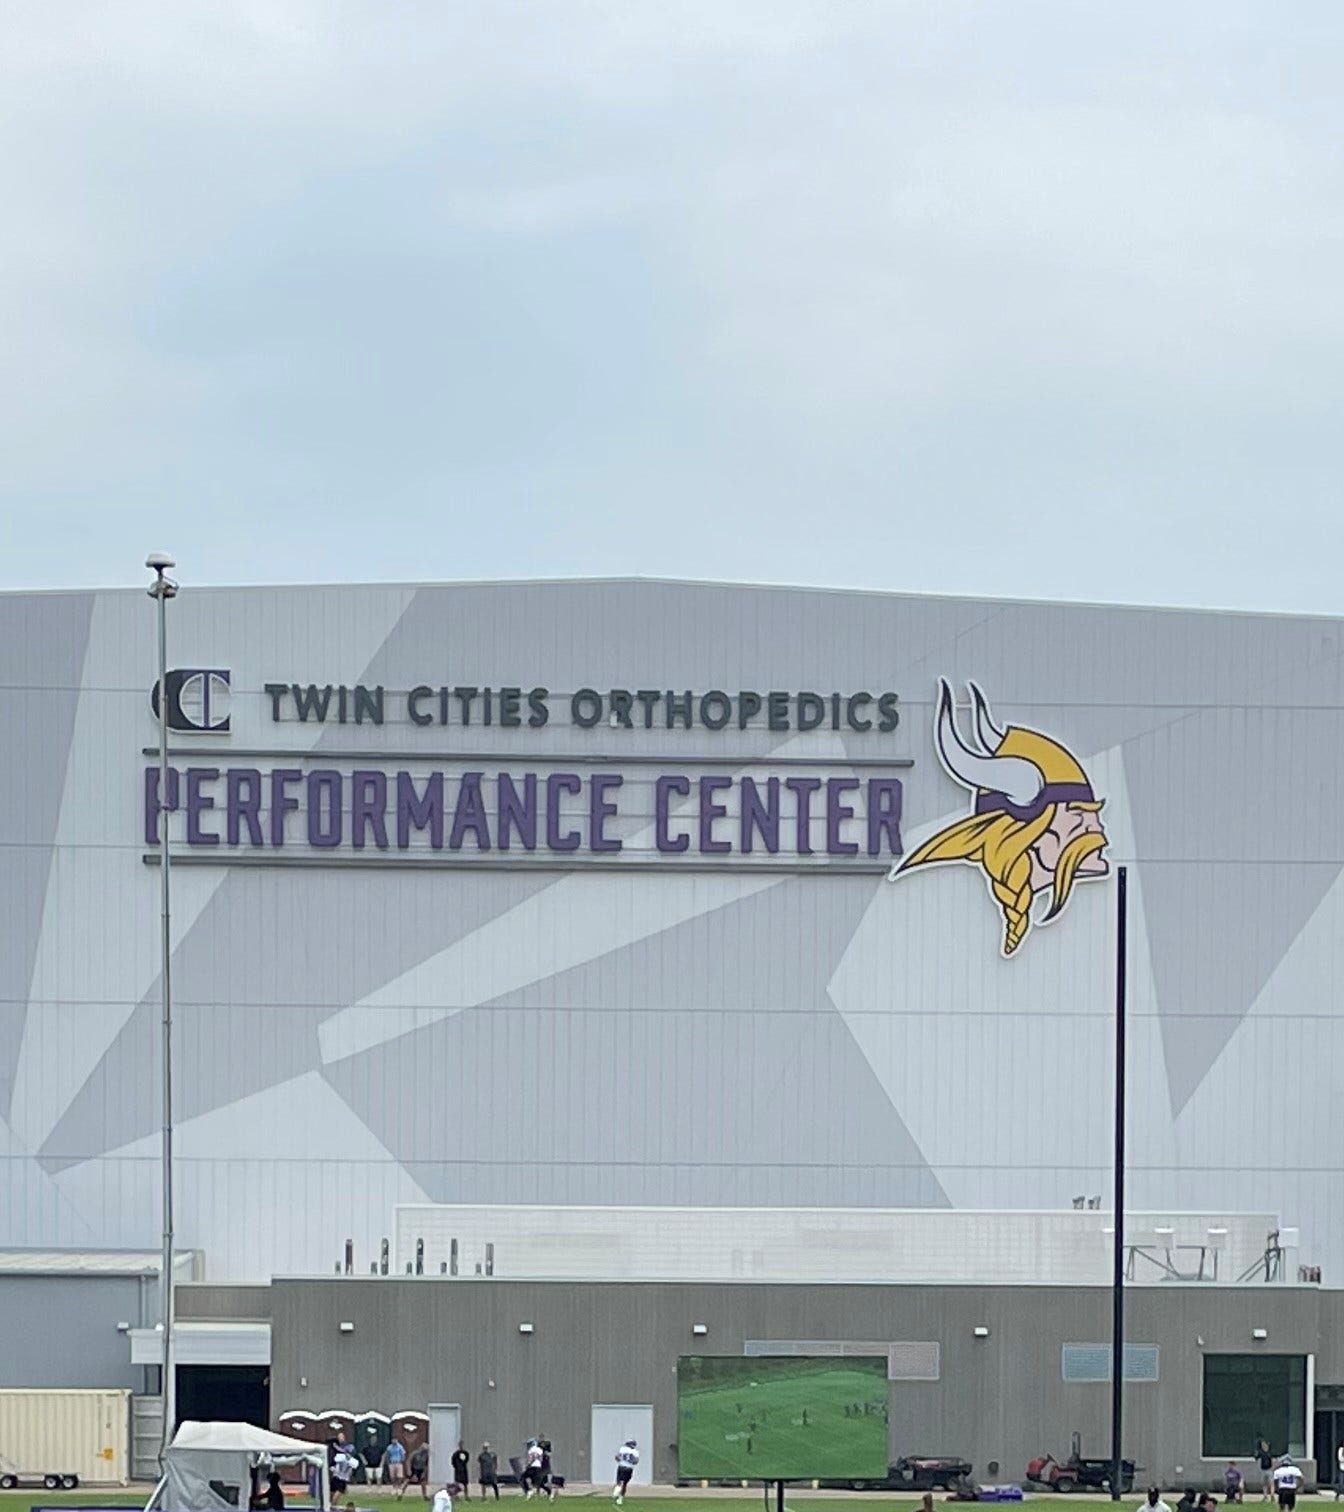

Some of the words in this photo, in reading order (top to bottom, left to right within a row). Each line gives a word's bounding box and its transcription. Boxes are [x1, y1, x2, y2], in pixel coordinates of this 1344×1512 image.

[264, 683, 384, 725] TWIN
[408, 685, 549, 727] CITIES
[571, 688, 900, 732] ORTHOPEDICS
[144, 767, 623, 851] PERFORMANCE
[656, 775, 904, 855] CENTER
